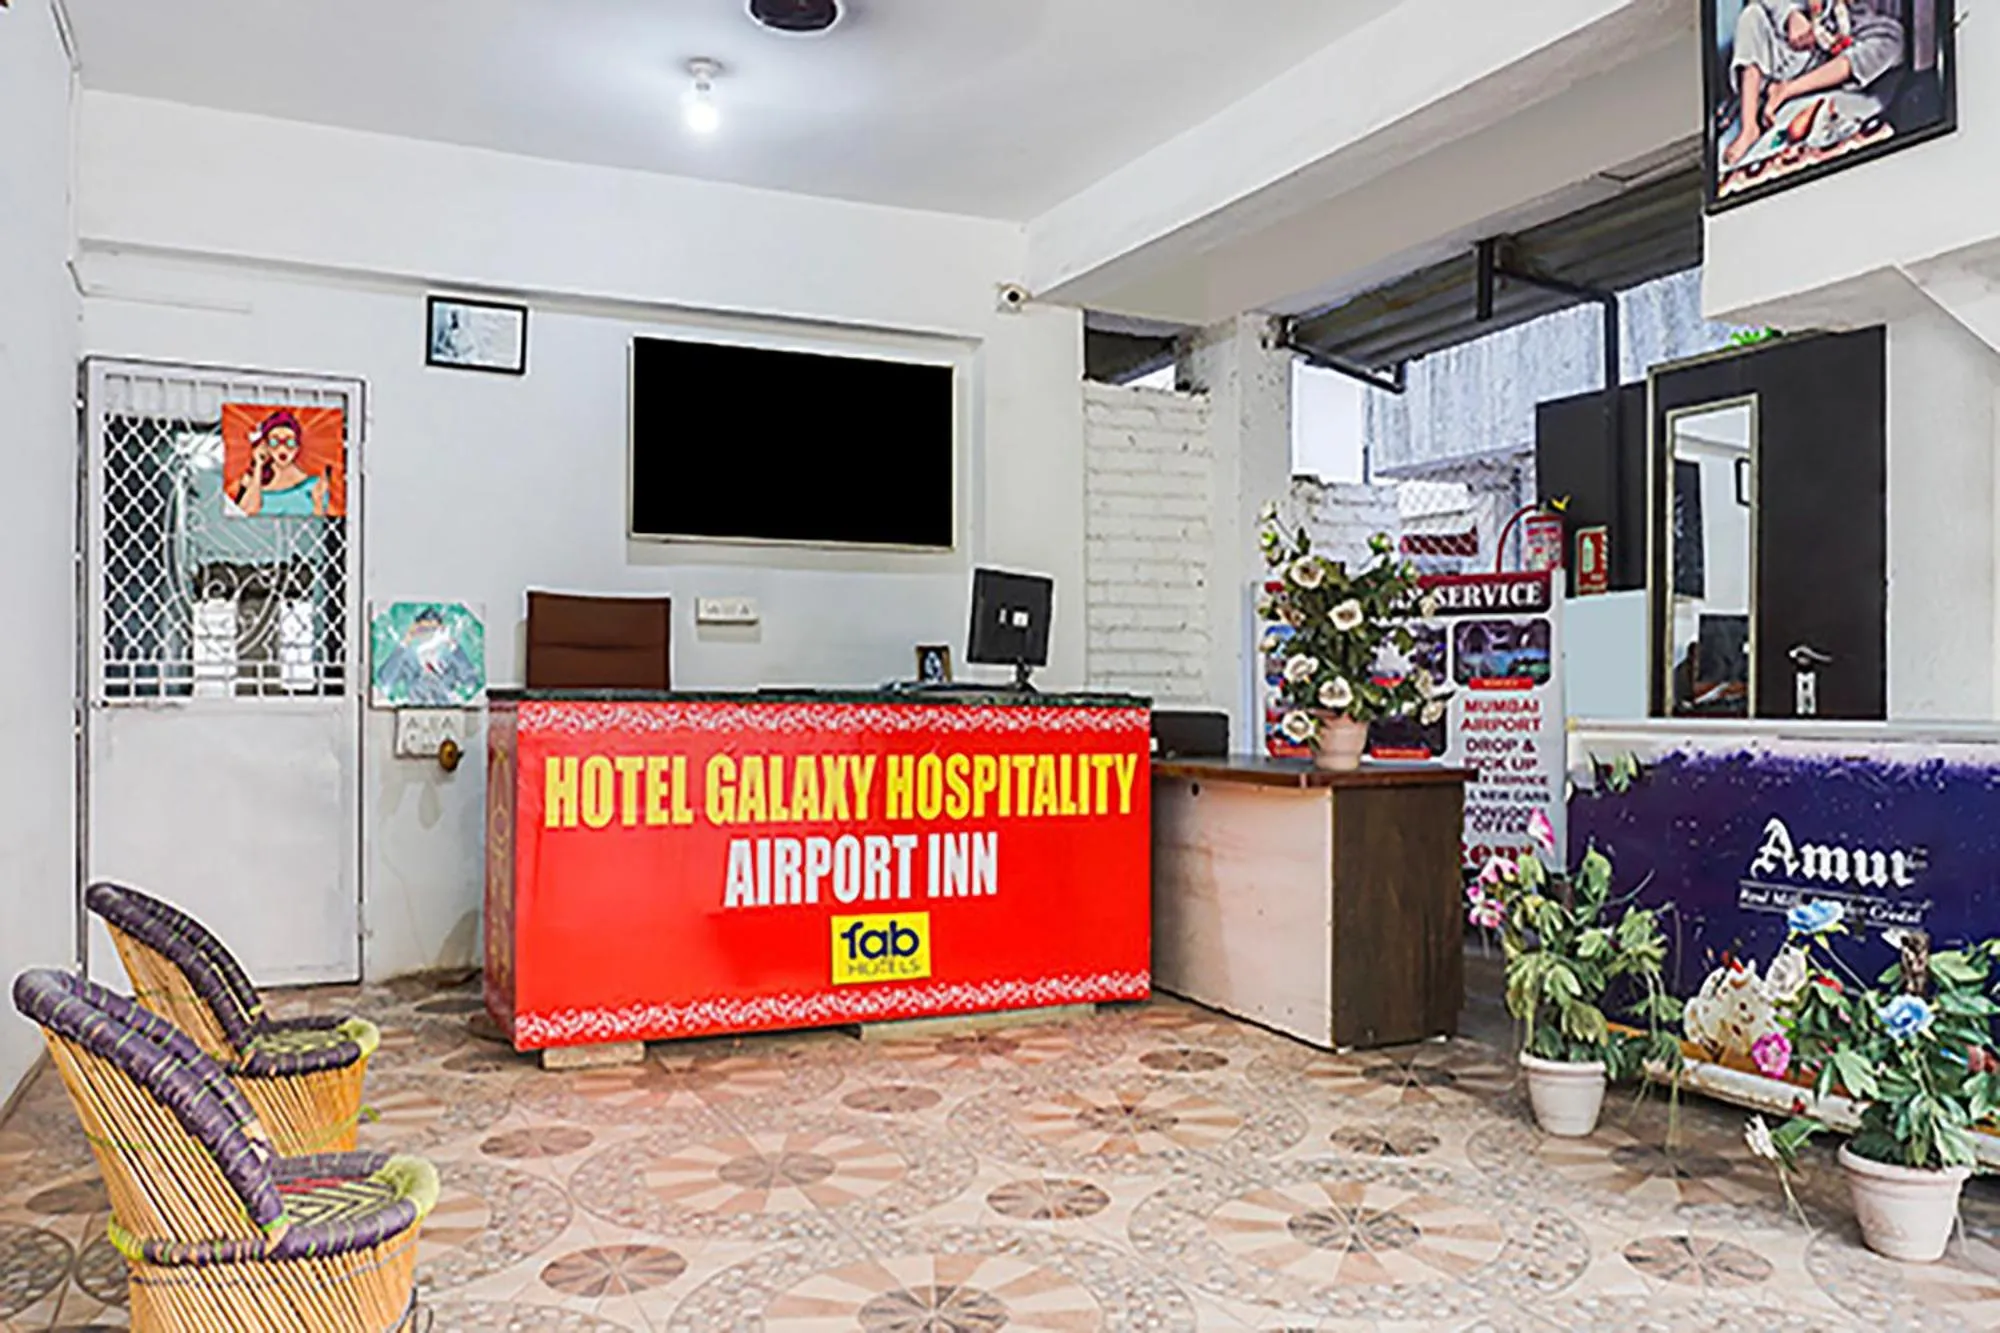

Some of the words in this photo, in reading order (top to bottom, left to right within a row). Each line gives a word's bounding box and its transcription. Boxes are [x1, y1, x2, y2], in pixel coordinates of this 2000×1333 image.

[1434, 581, 1542, 608] SERVICE
[1464, 699, 1539, 713] MUMBAI
[1460, 717, 1541, 732] AIRPORT
[1466, 738, 1518, 753] DROP
[1511, 757, 1537, 770] UP
[544, 755, 693, 828] HOTEL
[705, 751, 876, 825] GALAXY
[886, 751, 1139, 822] HOSPITALITY
[723, 834, 919, 909] AIRPORT
[927, 830, 998, 899] INN
[840, 920, 920, 960] fab
[847, 959, 921, 977] HOTELS
